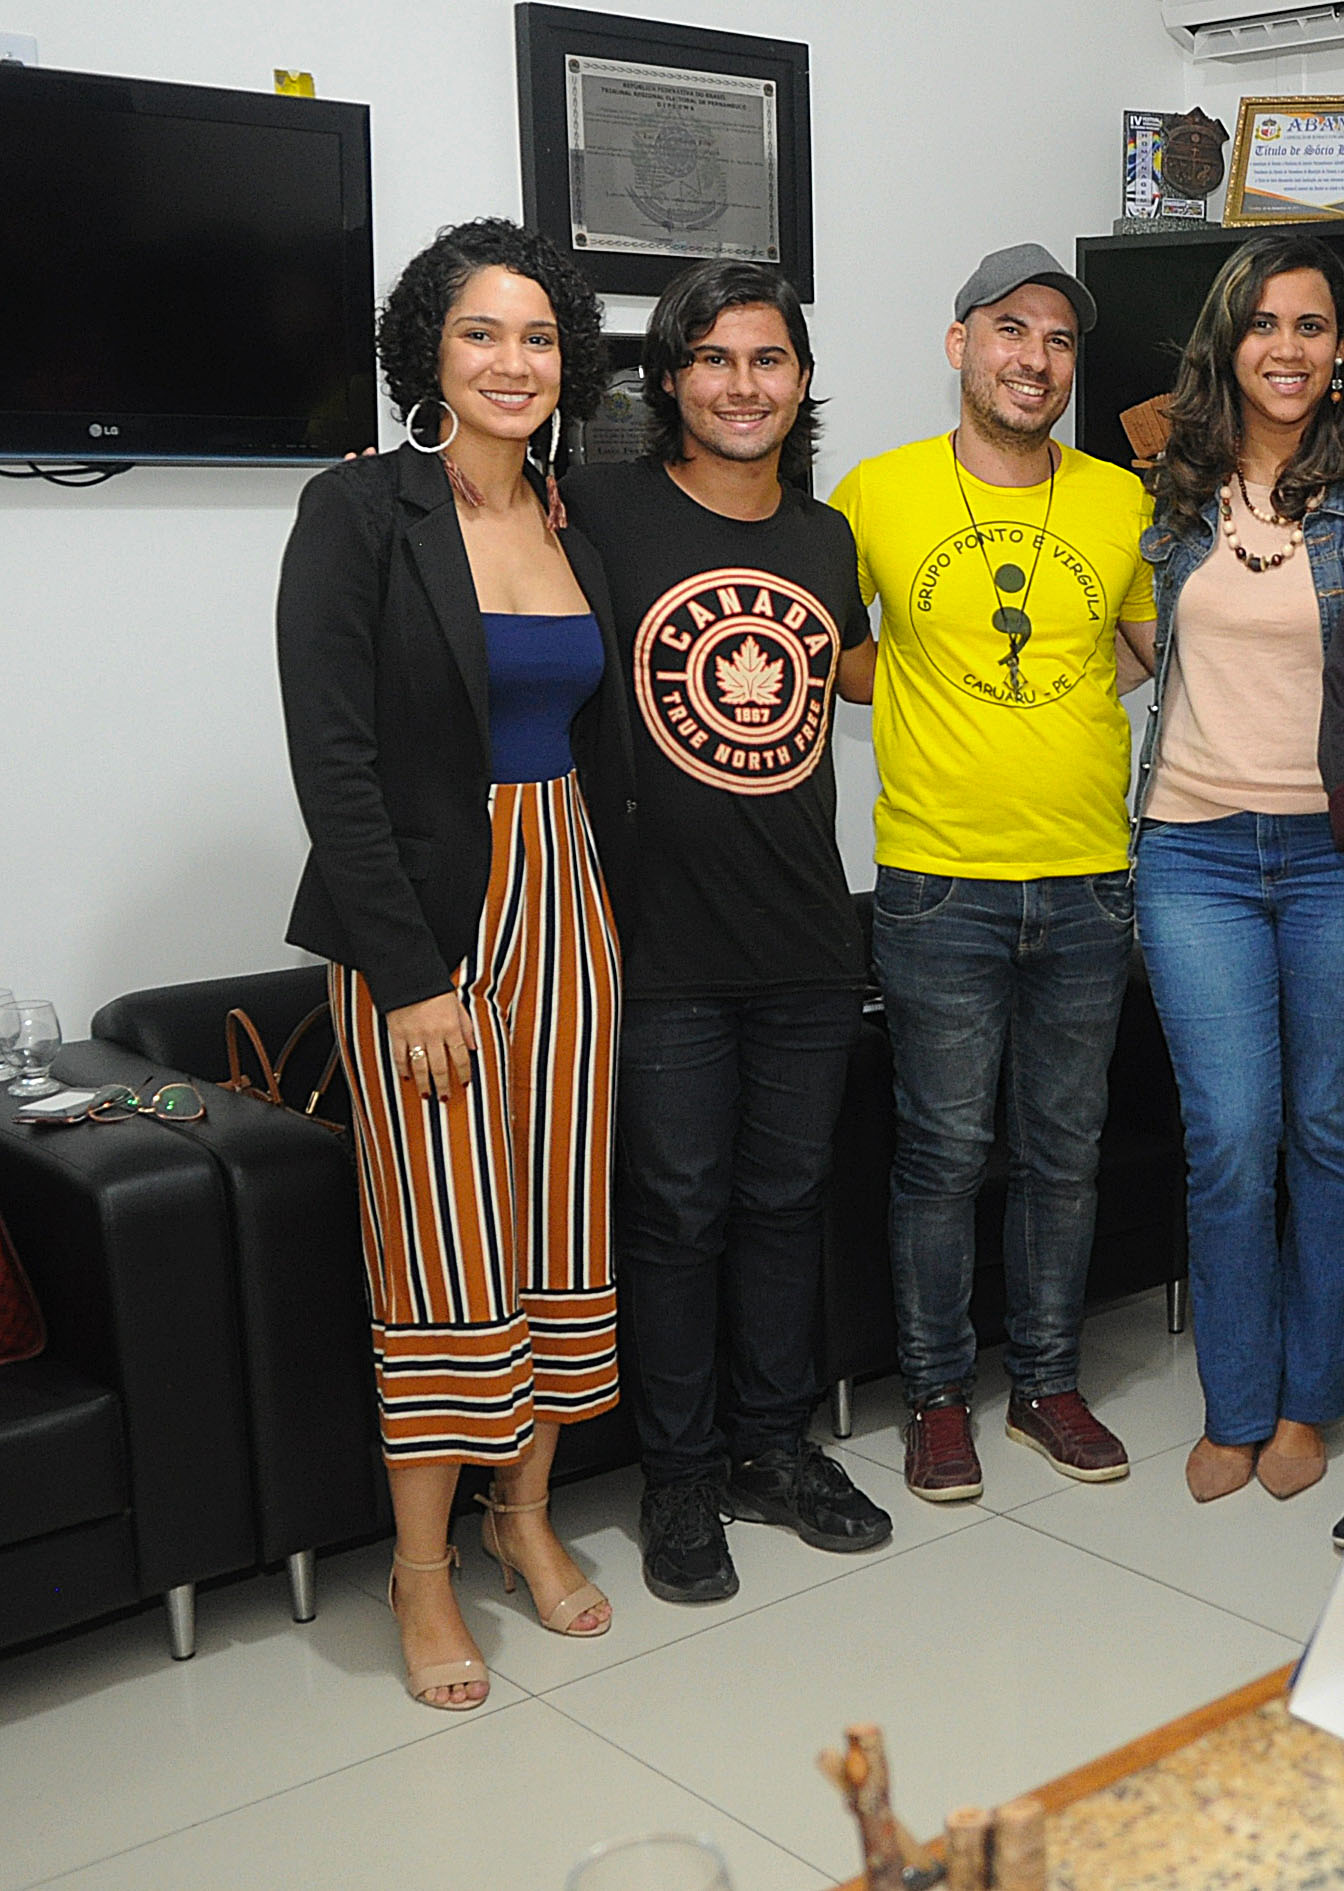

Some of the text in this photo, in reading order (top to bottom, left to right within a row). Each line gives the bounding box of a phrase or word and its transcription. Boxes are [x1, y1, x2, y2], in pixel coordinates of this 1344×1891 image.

[1130, 115, 1142, 126] IV
[1290, 146, 1300, 156] de
[1304, 144, 1334, 156] Sócio
[103, 426, 119, 435] LG
[917, 528, 1101, 622] GRUPO PONTO E VIRGULA
[658, 586, 831, 658] CANADA
[963, 673, 1036, 704] CARUARU
[1051, 673, 1072, 695] PE
[661, 690, 822, 771] TRUE NORTH FREE
